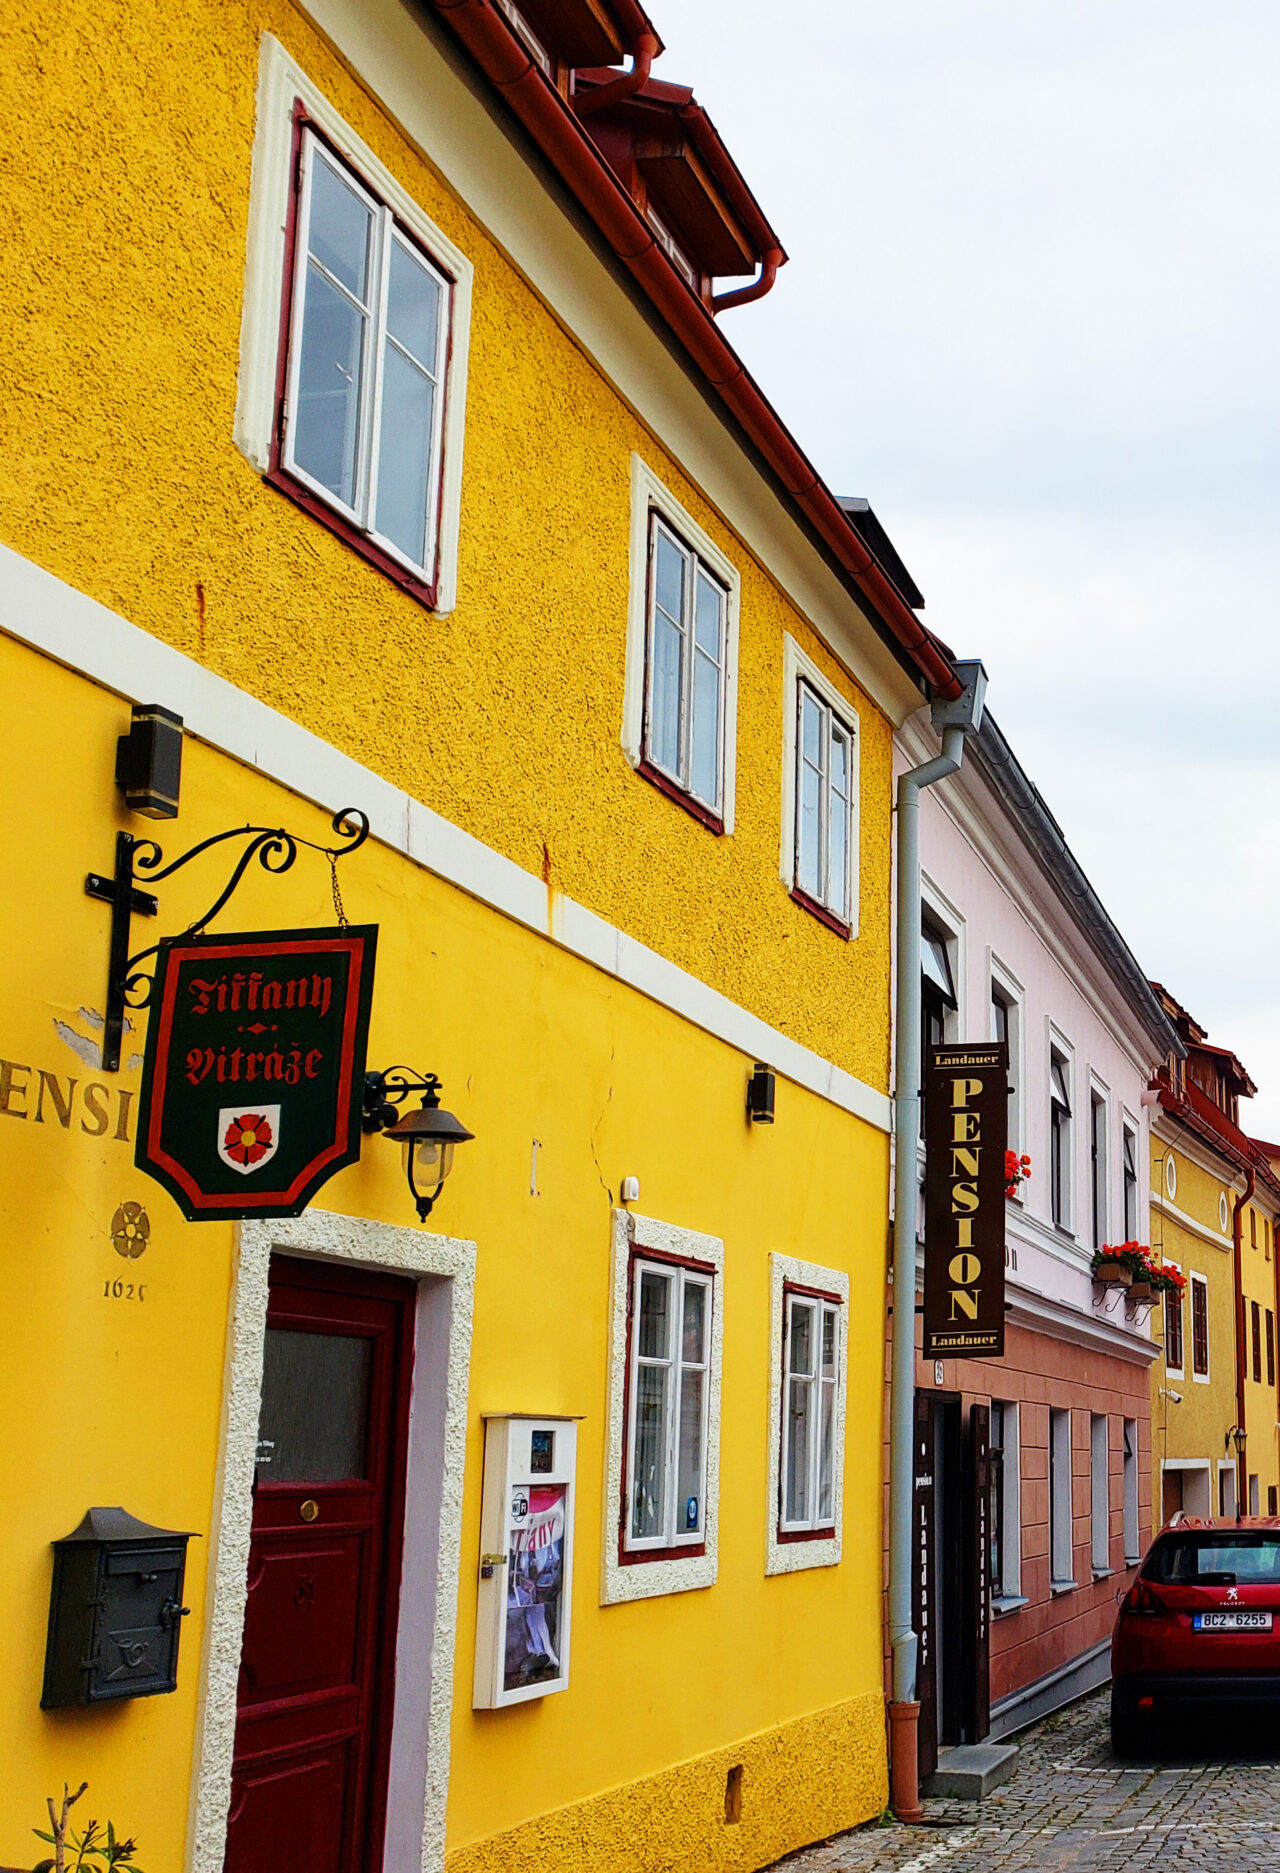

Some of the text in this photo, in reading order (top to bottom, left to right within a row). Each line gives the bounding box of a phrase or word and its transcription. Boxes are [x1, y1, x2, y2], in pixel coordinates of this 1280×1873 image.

[188, 971, 332, 1018] Tiffany
[184, 1041, 324, 1086] Vitráže
[934, 1053, 999, 1066] Landauer
[947, 1078, 984, 1321] PENSION
[931, 1335, 998, 1347] Landauer
[915, 1473, 933, 1490] pension
[920, 1504, 928, 1666] Landauer
[1204, 1614, 1227, 1626] 8C2
[1236, 1613, 1266, 1626] 6255
